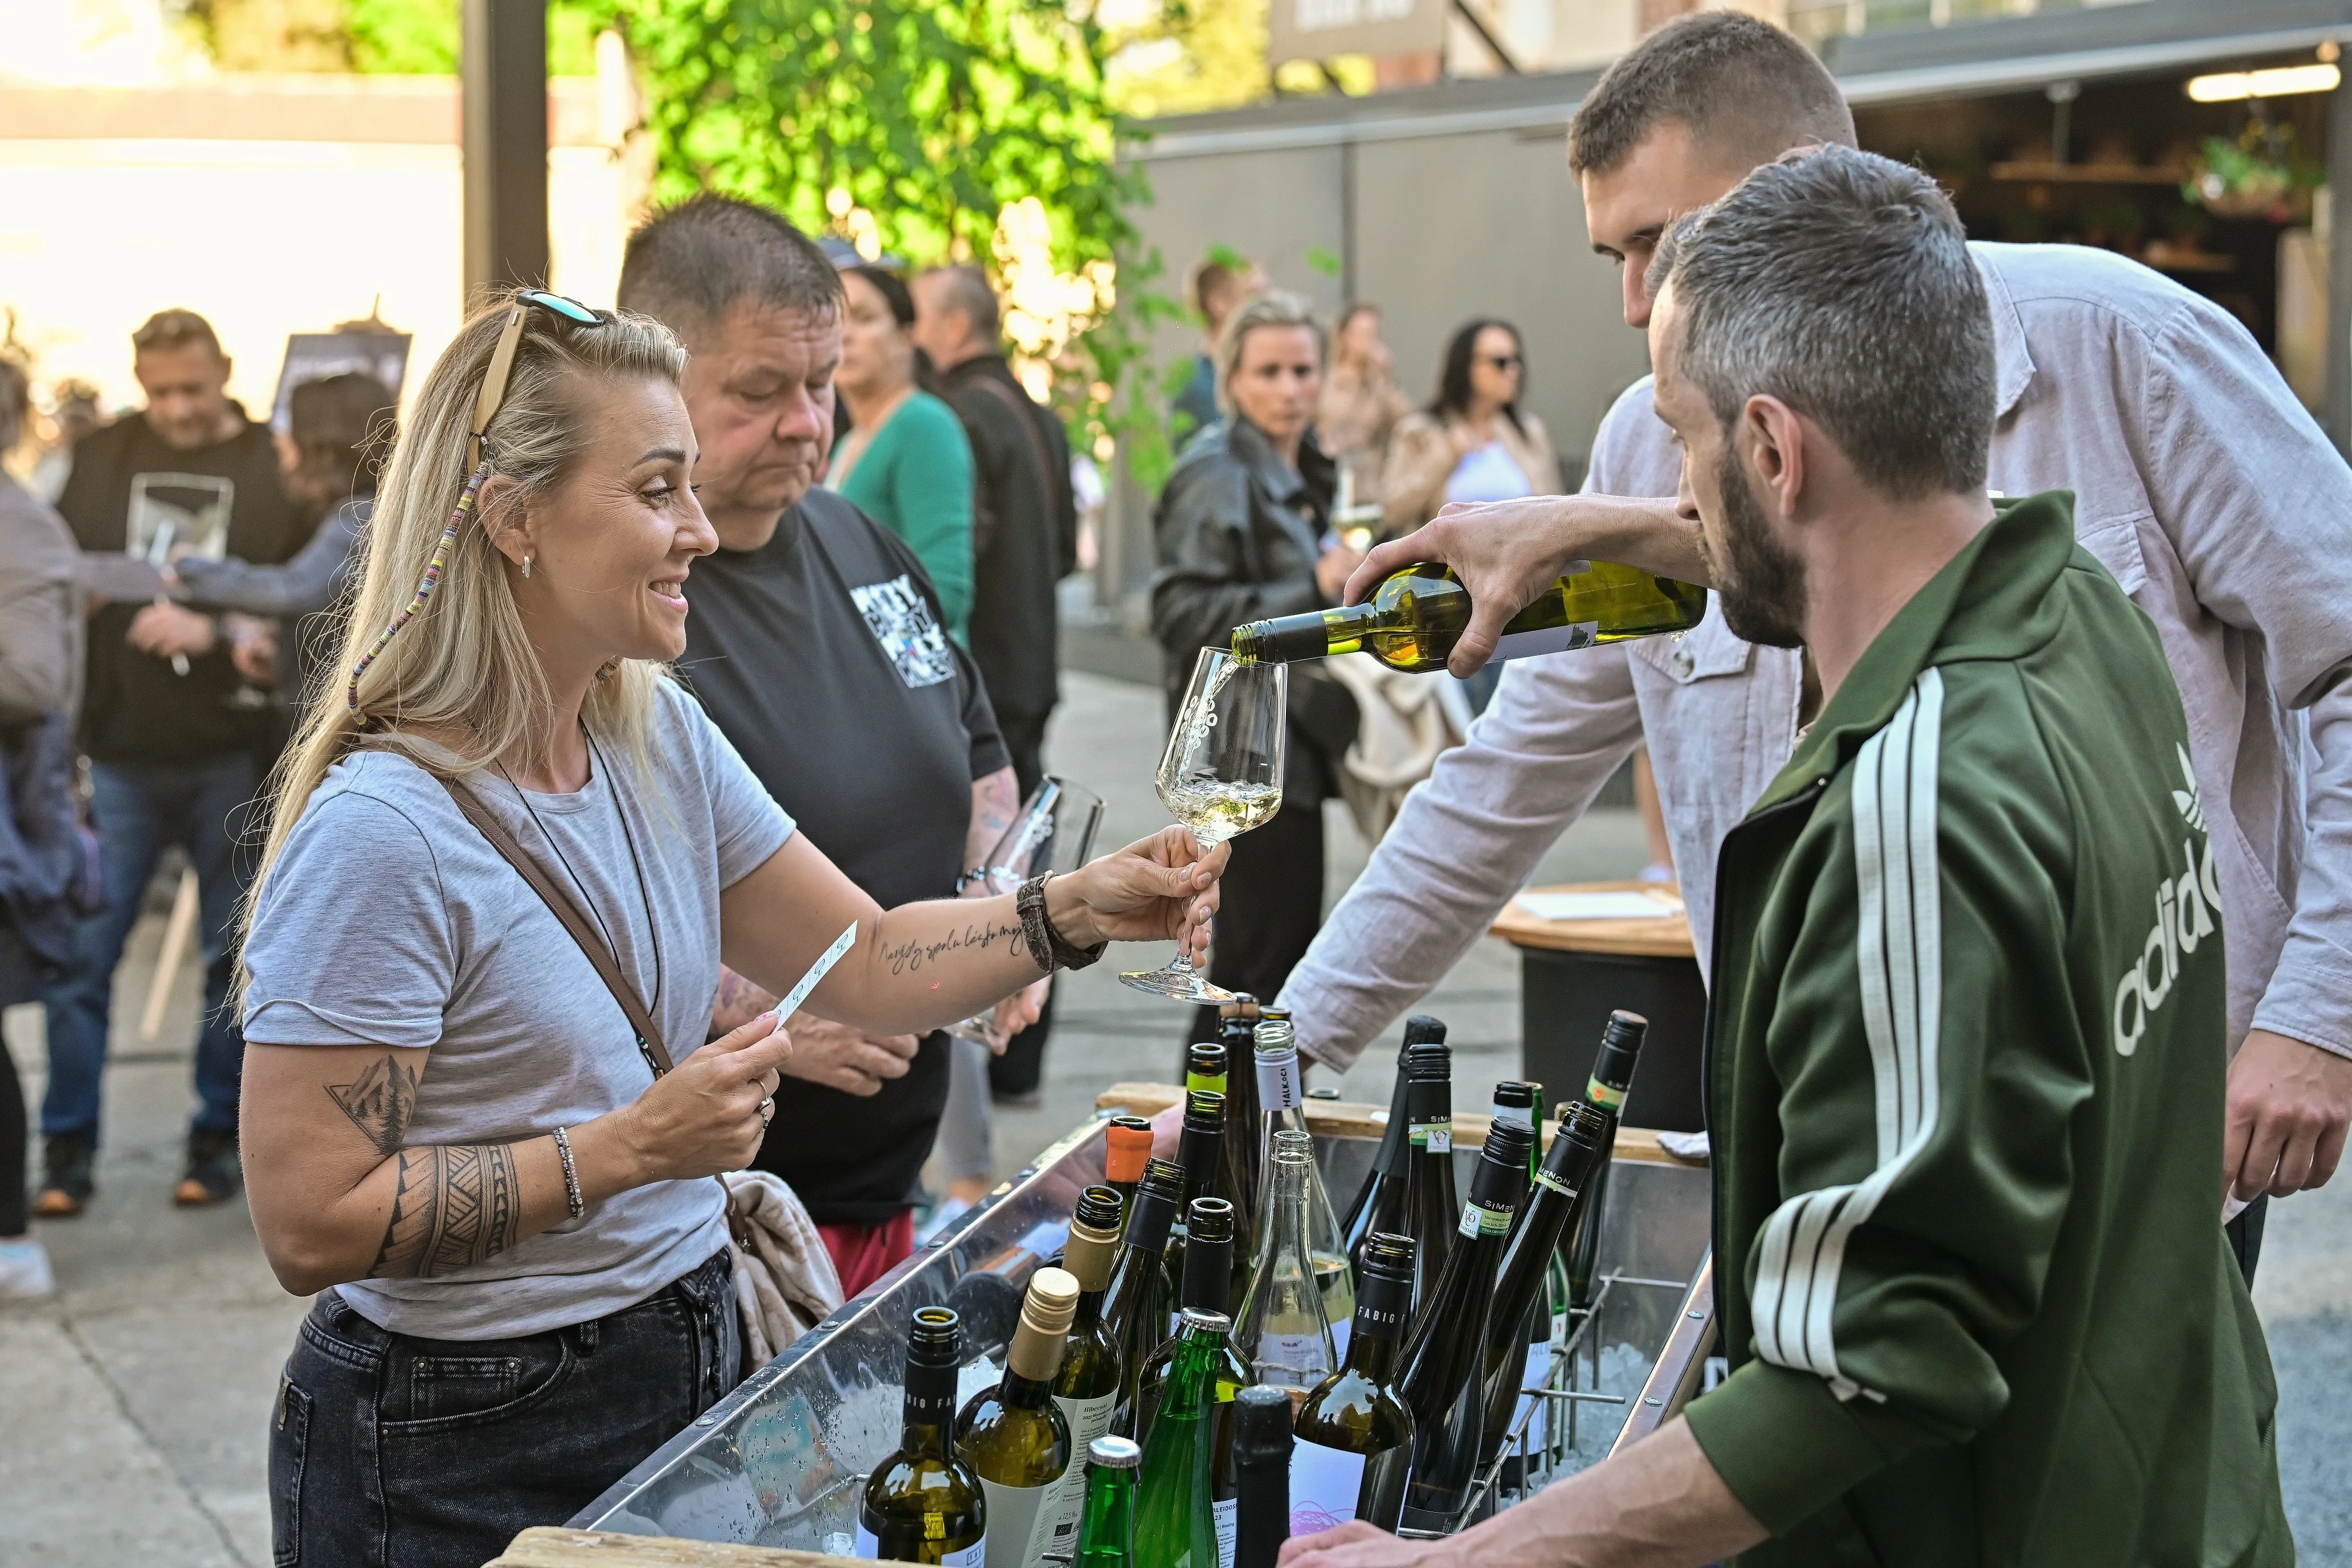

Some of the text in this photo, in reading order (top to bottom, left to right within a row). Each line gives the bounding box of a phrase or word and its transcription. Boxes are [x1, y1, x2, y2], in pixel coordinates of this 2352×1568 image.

[1358, 1305, 1395, 1324] FABIG
[1084, 1402, 1108, 1412] Hibernal
[1063, 1512, 1071, 1521] 12,5
